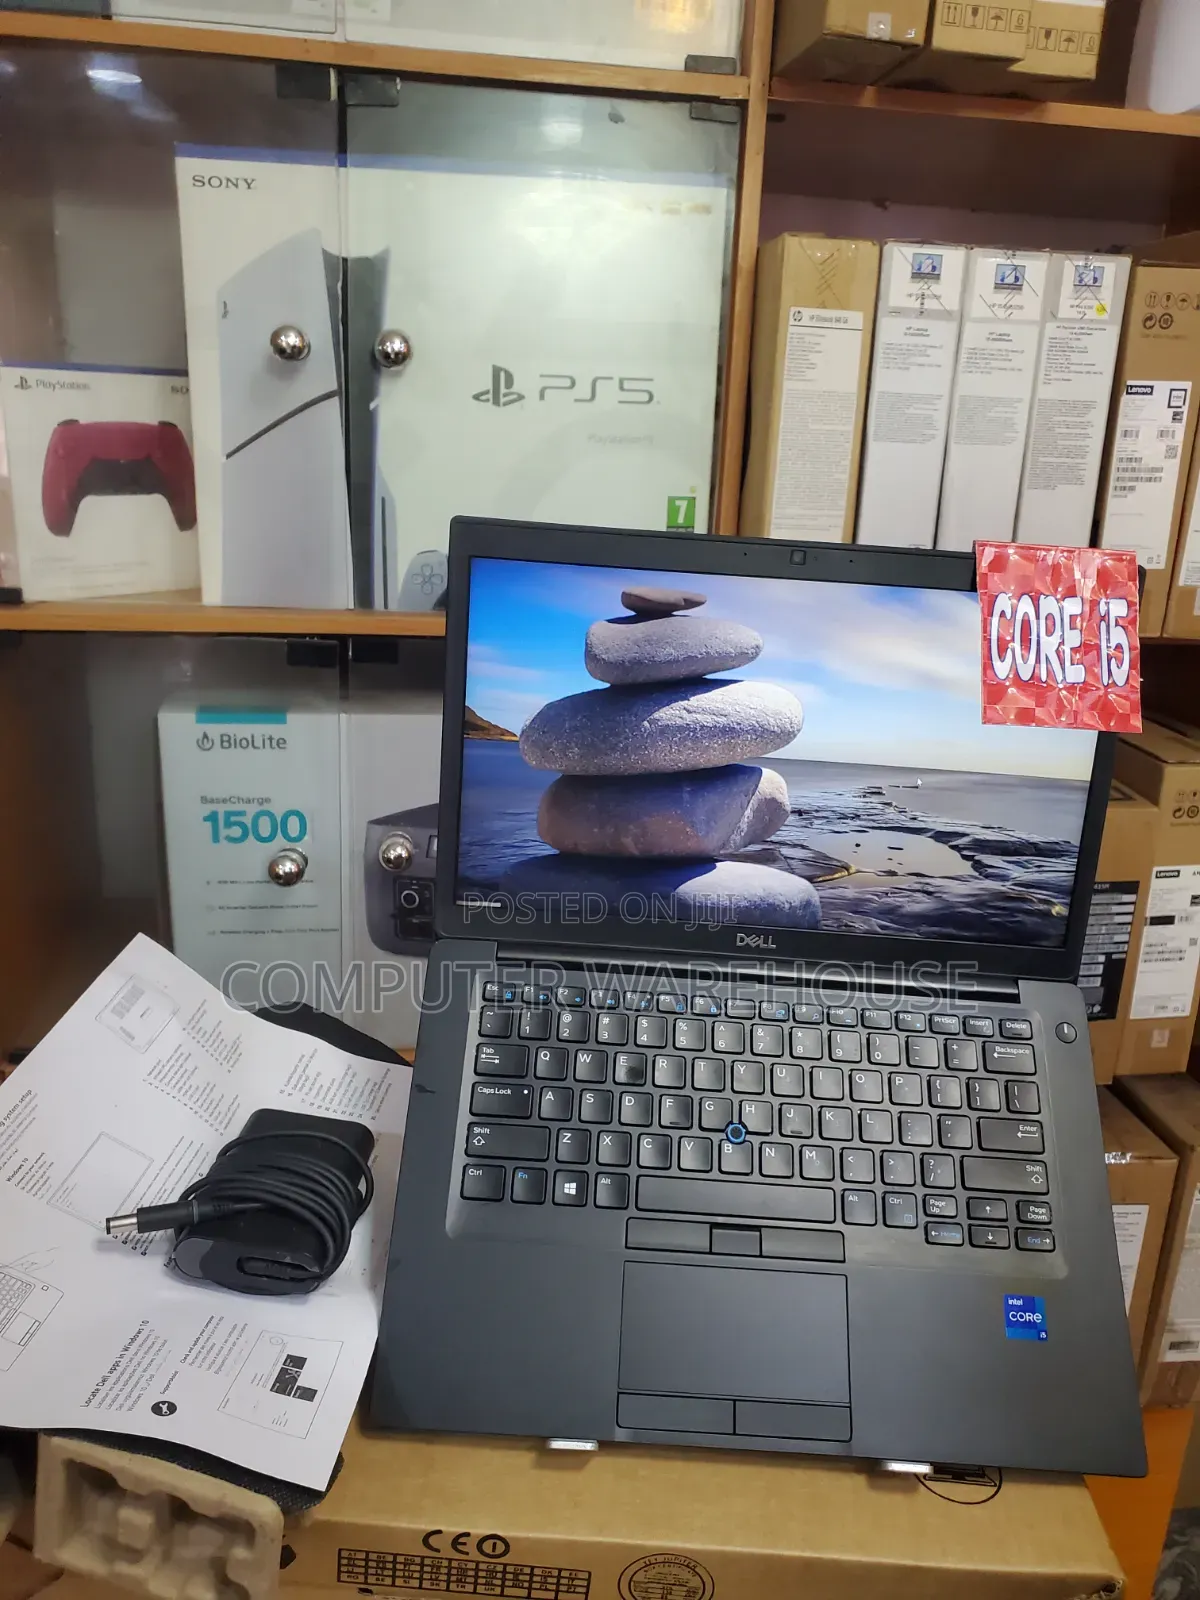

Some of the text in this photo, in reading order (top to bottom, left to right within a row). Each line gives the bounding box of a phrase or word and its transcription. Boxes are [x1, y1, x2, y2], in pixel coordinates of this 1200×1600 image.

[1016, 12, 1024, 26] 6
[192, 174, 256, 190] SONY
[36, 378, 91, 392] PlayStation
[539, 374, 655, 405] PS5
[675, 500, 688, 524] 7
[990, 592, 1130, 687] CORE i5
[219, 734, 288, 750] BioLite
[200, 795, 272, 806] BaseCharge
[202, 808, 308, 845] 1500
[736, 933, 776, 949] DELL
[934, 1016, 957, 1025] PrtScr
[969, 1019, 989, 1027] Insert
[525, 1026, 530, 1034] 1
[1006, 1022, 1027, 1030] Delete
[563, 1028, 570, 1036] 2
[602, 1031, 609, 1039] 3
[641, 1034, 648, 1042] 4
[679, 1036, 686, 1044] 5
[719, 1039, 725, 1047] 6
[995, 1045, 1030, 1055] Backspace
[541, 1051, 550, 1062] Q
[579, 1054, 592, 1062] W
[620, 1057, 628, 1065] E
[659, 1060, 667, 1068] R
[698, 1062, 706, 1071] T
[737, 1065, 746, 1074] Y
[777, 1068, 786, 1077] U
[856, 1074, 865, 1083] O
[896, 1076, 903, 1085] P
[478, 1086, 494, 1095] Caps
[19, 1089, 32, 1104] setup
[545, 1091, 555, 1101] A
[586, 1094, 594, 1103] S
[625, 1096, 634, 1106] D
[666, 1099, 674, 1108] F
[705, 1101, 714, 1111] G
[746, 1104, 755, 1114] H
[786, 1108, 794, 1117] J
[826, 1111, 834, 1121] K
[867, 1114, 874, 1123] L
[473, 1126, 490, 1135] Shift
[563, 1133, 571, 1143] Z
[603, 1136, 612, 1145] X
[644, 1138, 652, 1148] C
[684, 1141, 694, 1150] V
[724, 1144, 732, 1153] B
[766, 1148, 775, 1157] N
[806, 1150, 816, 1159] M
[6, 1163, 24, 1182] Windows
[468, 1168, 482, 1177] Ctrl
[1026, 1164, 1042, 1173] Shift
[600, 1177, 611, 1185] Alt
[929, 1200, 946, 1208] Page
[1008, 1297, 1023, 1305] intel
[80, 1385, 102, 1408] Locate
[96, 1375, 111, 1387] Dell
[108, 1359, 122, 1374] apps
[122, 1328, 145, 1351] Windows
